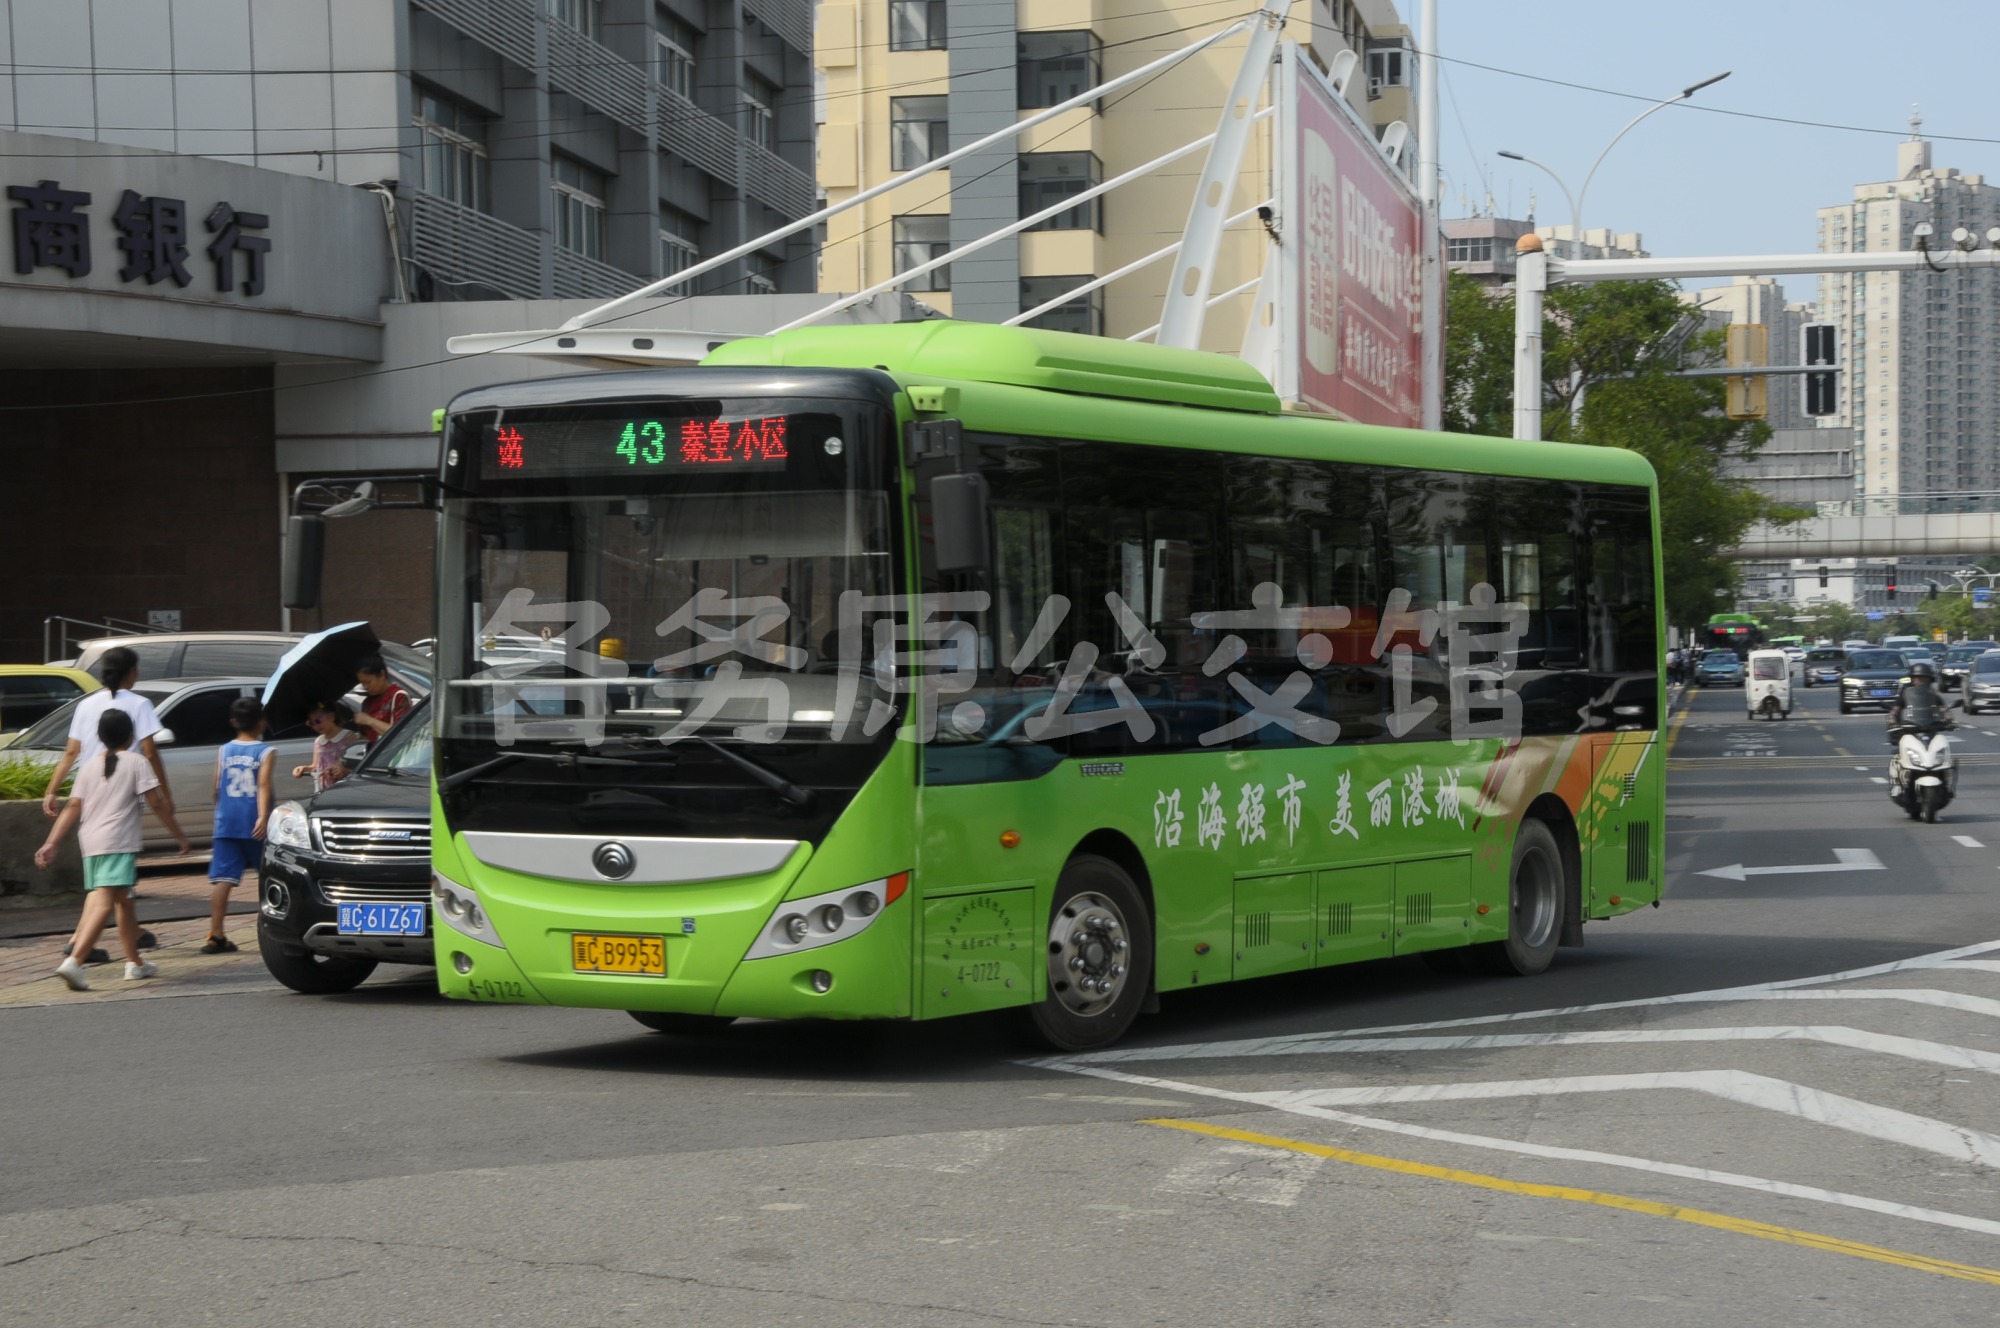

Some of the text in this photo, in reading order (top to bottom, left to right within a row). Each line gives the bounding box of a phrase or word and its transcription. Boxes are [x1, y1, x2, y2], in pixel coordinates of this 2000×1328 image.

[6, 179, 272, 297] 商银行
[616, 421, 666, 464] 43
[680, 417, 788, 463] 秦皇小区
[226, 767, 257, 798] 24
[1153, 764, 1465, 851] 沿海强市 美丽港城
[957, 962, 1001, 984] 4-0722
